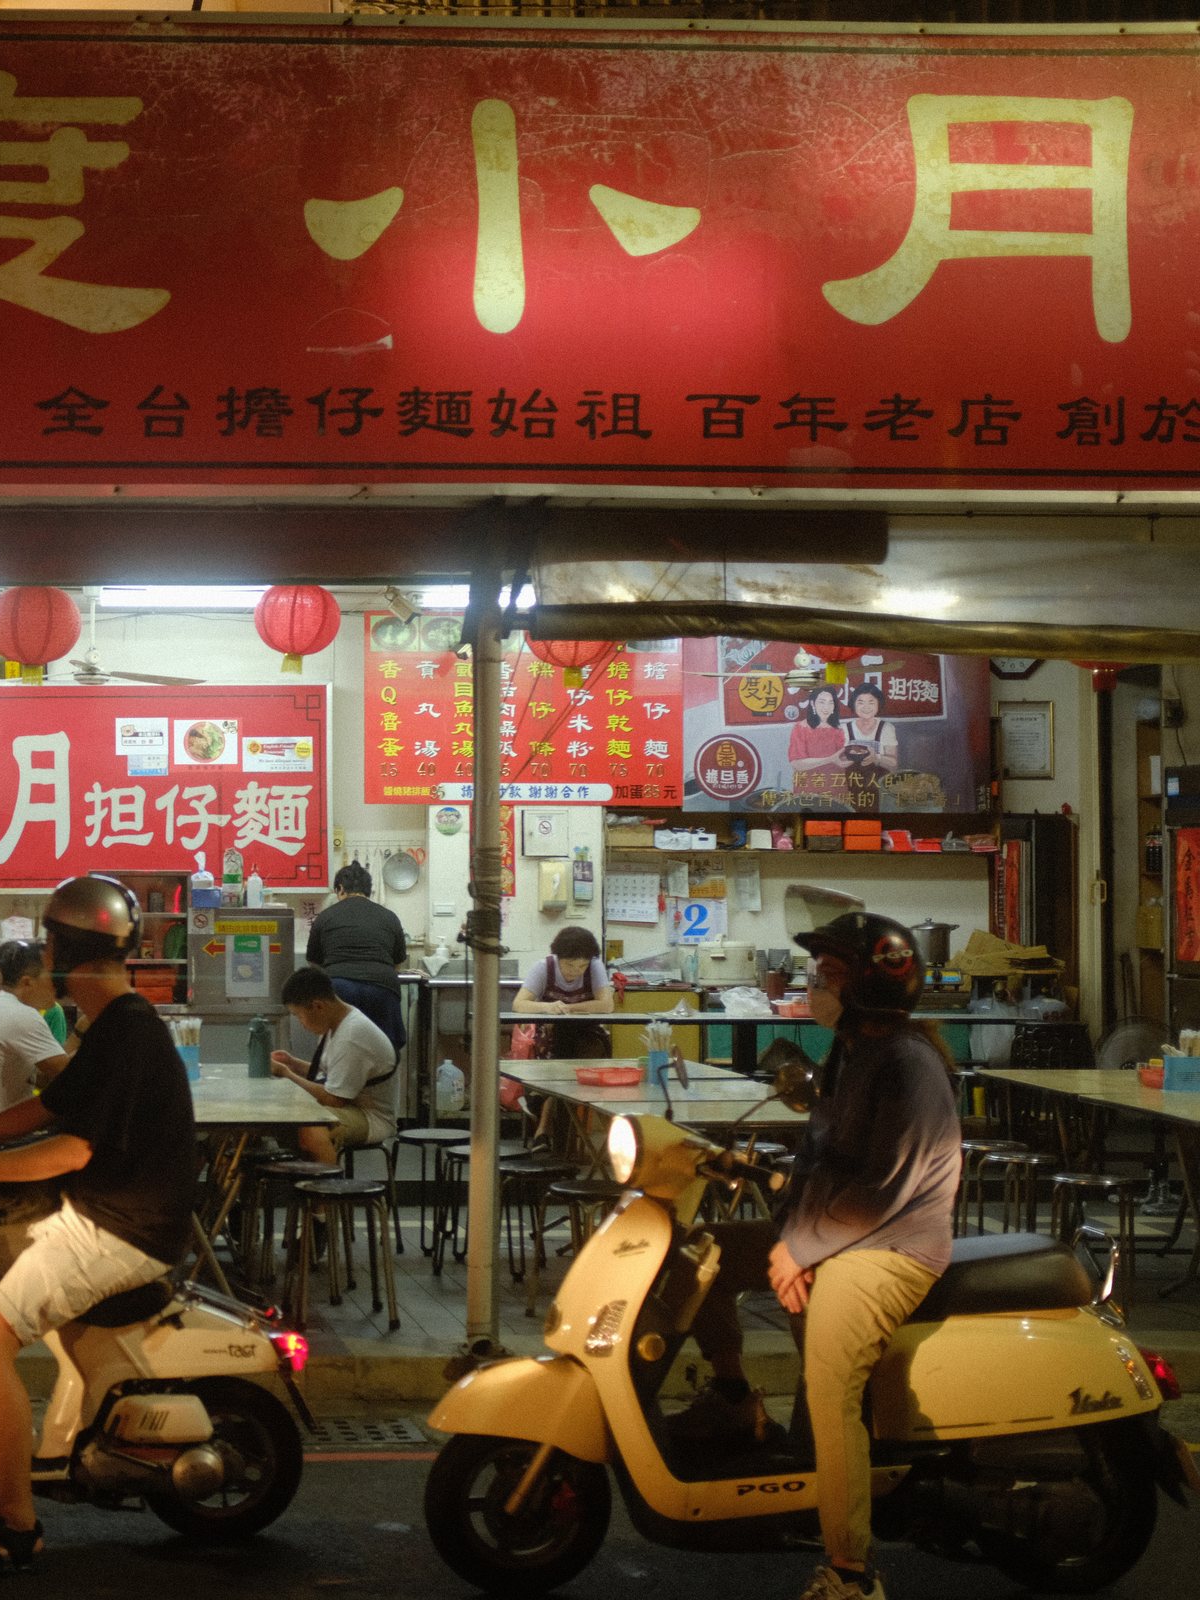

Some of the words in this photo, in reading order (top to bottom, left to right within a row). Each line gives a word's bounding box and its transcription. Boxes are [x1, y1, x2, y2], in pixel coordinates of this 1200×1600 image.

[35, 384, 653, 441] 全台擔仔麵始祖
[685, 393, 1022, 447] 百年老店
[414, 660, 442, 758] 貢丸湯
[605, 661, 633, 759] 擔仔乾麵
[643, 661, 671, 759] 擔仔麵
[529, 785, 590, 799] 謝謝合作
[683, 903, 711, 937] 2
[736, 1481, 806, 1496] PGO
